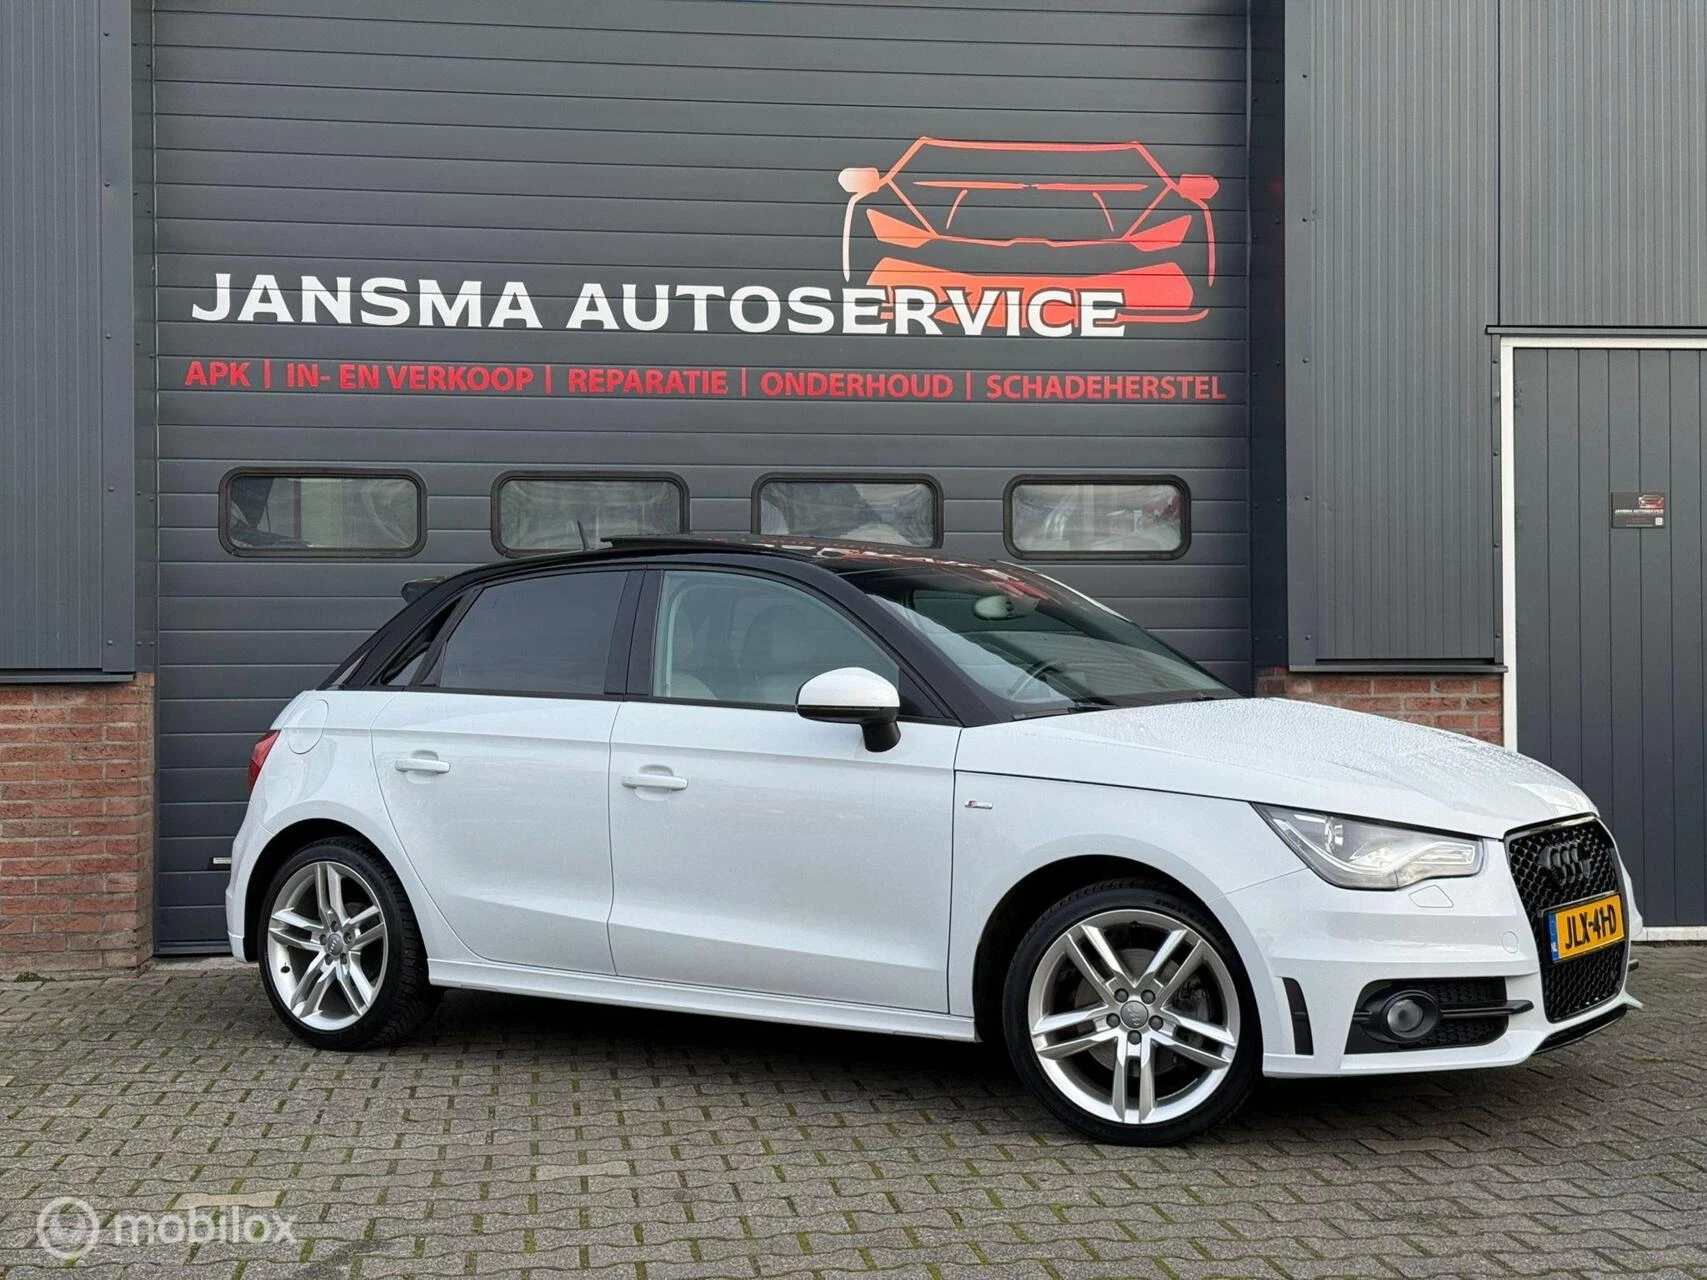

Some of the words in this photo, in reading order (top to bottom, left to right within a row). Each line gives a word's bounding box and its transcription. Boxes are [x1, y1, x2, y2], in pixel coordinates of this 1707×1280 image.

[191, 273, 543, 329] JANSMA
[565, 282, 1126, 338] AUTOSERVICE
[184, 360, 251, 387] APK
[286, 362, 331, 388] IN-
[338, 363, 381, 390] EN
[385, 364, 535, 393] VERKOOP
[567, 367, 729, 396] REPARATIE
[759, 370, 955, 399] ONDERHOUD
[985, 373, 1228, 402] SCHADEHERSTEL
